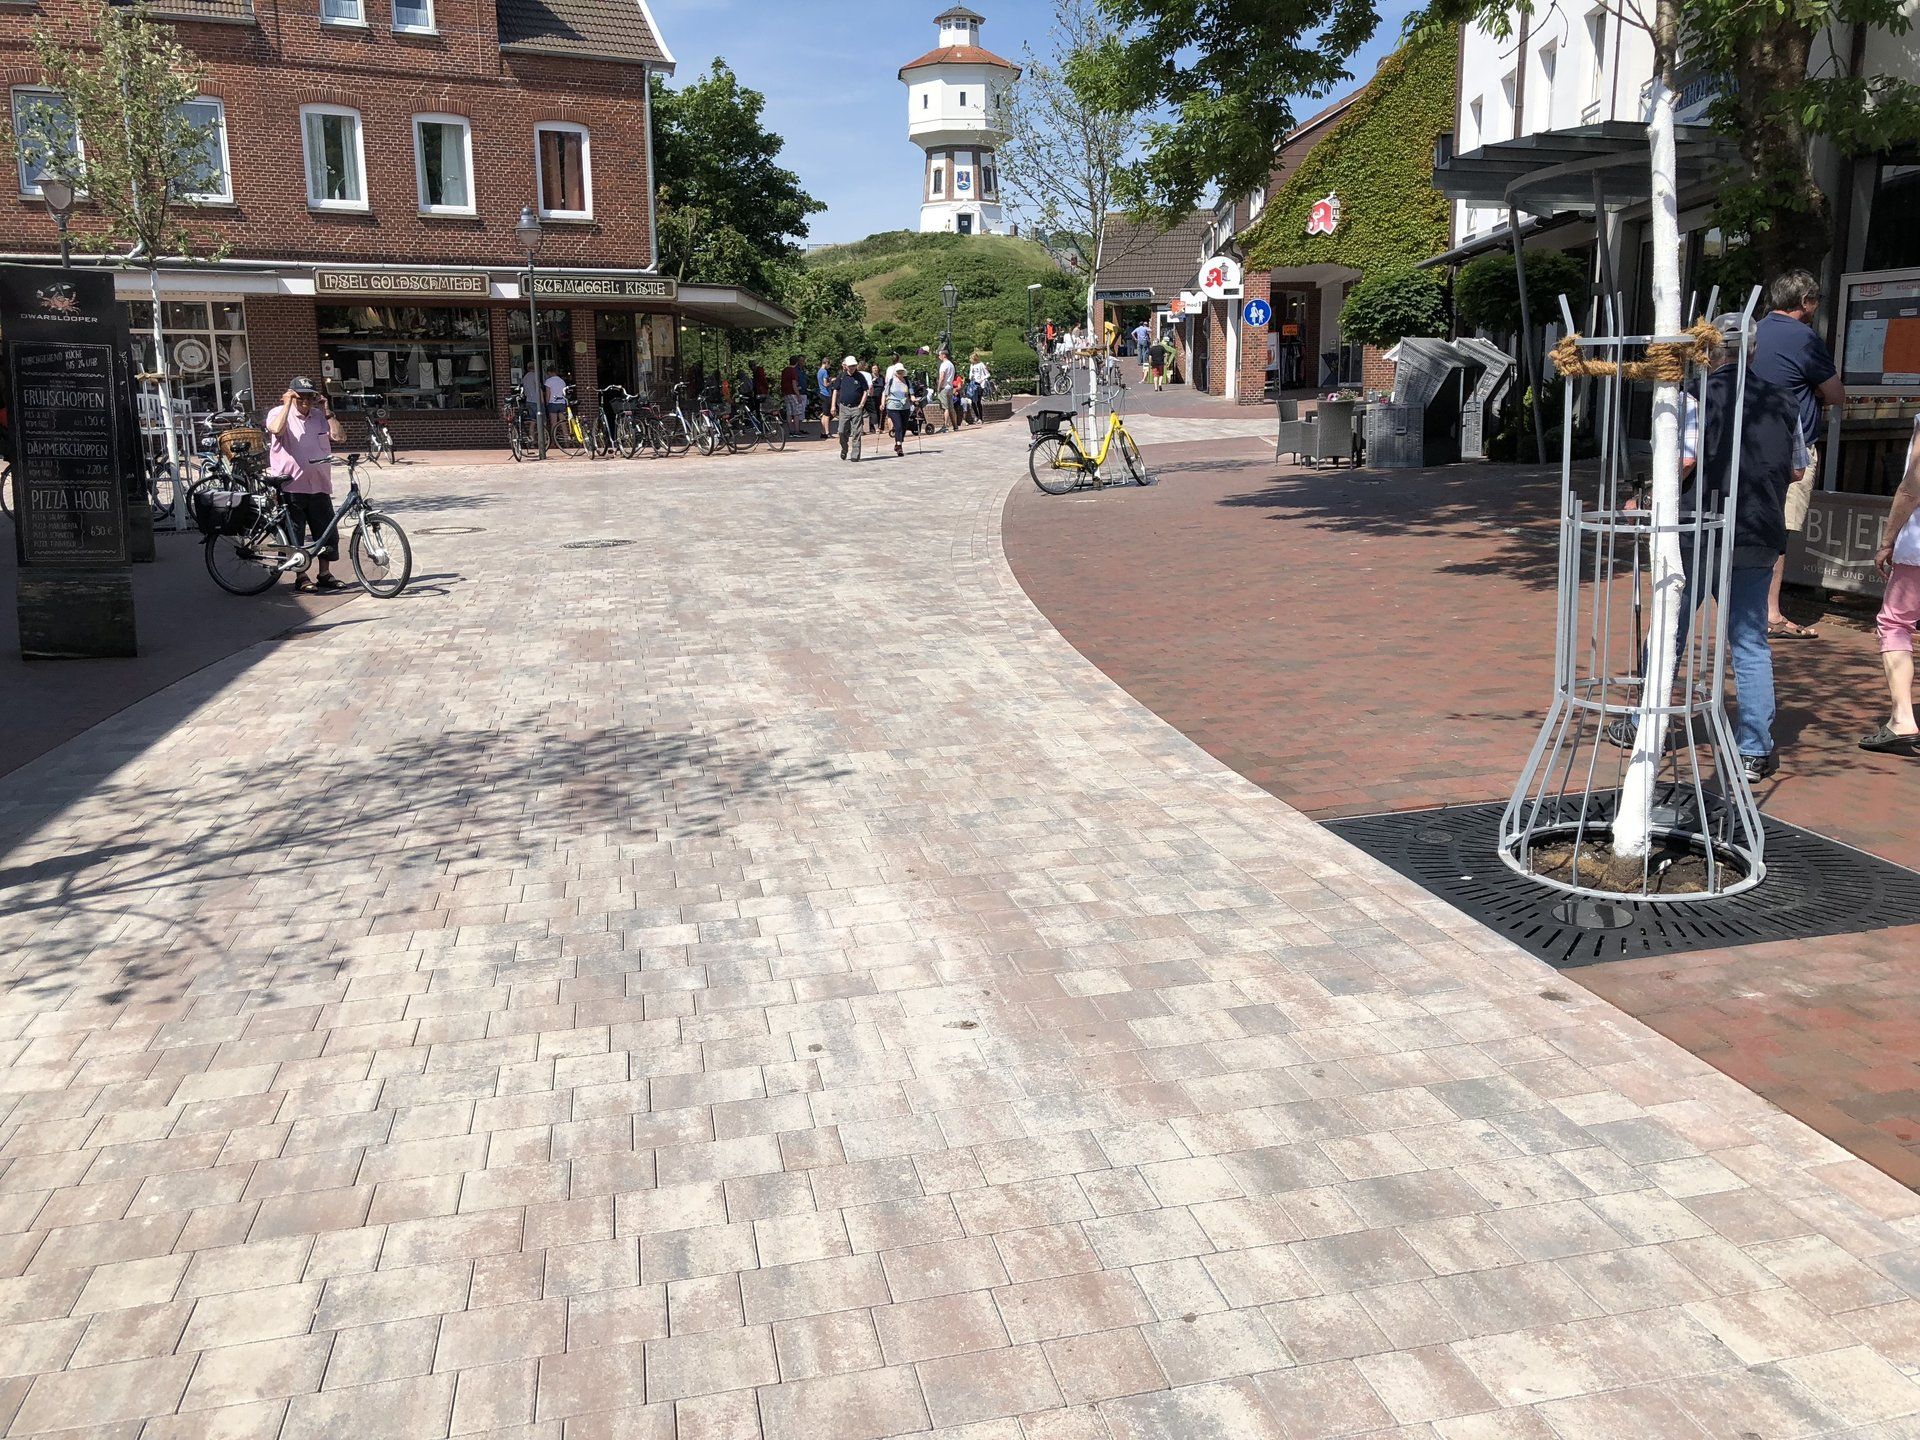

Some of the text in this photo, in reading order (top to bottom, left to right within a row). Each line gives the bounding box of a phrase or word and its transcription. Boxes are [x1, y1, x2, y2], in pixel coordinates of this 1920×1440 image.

[324, 274, 482, 291] INSEL GOLDSCHMIEDE
[534, 279, 666, 295] SCHMUGGEL KISTE
[20, 313, 98, 323] DWARSLOOPER
[23, 387, 105, 408] FRÜHSCHOPPEN
[27, 440, 109, 457] DÄMMERSCHOPPEN
[31, 489, 110, 511] PIZZA HOUR
[1842, 571, 1865, 581] UND
